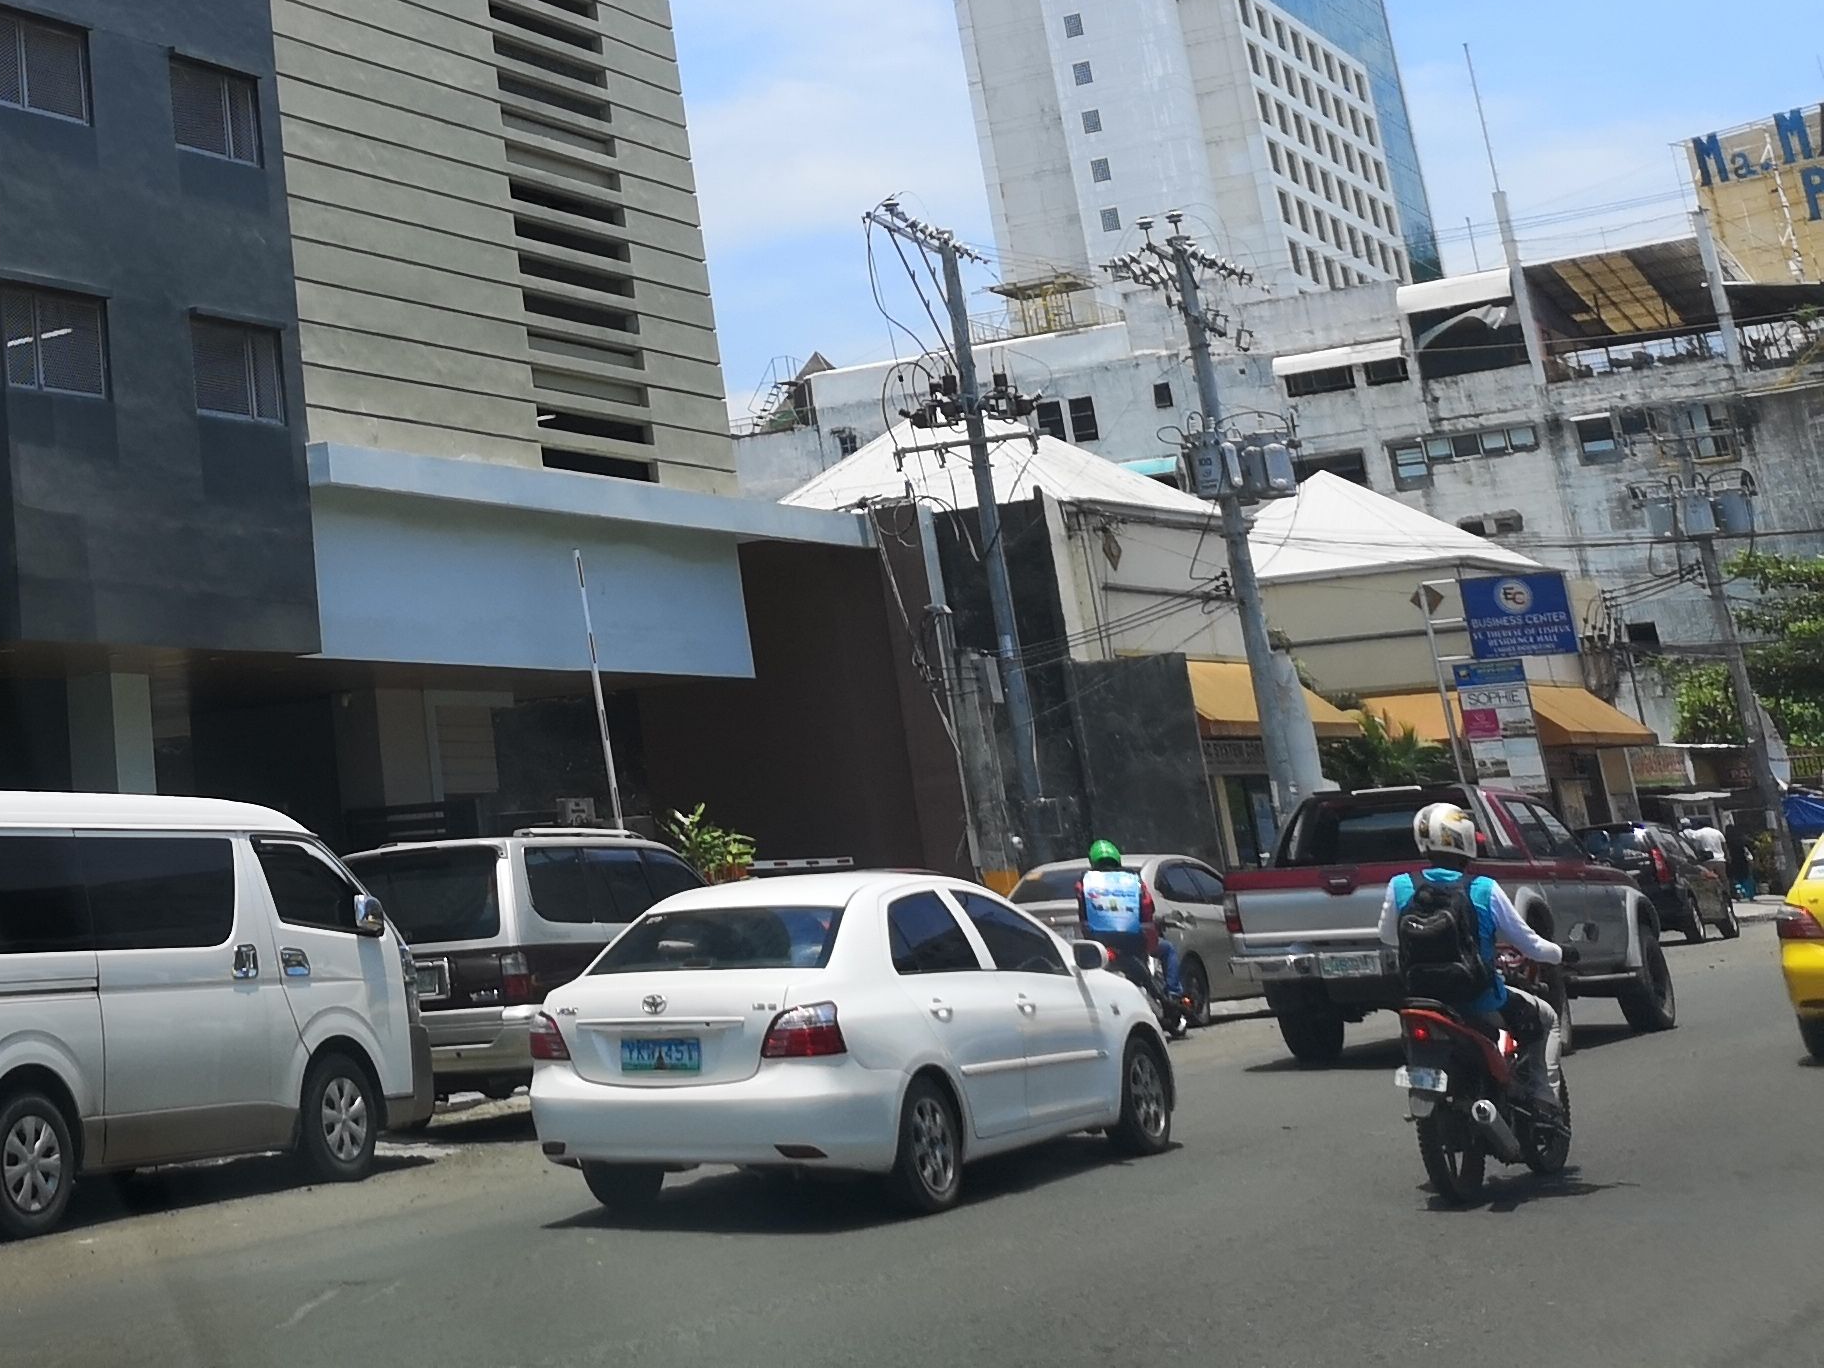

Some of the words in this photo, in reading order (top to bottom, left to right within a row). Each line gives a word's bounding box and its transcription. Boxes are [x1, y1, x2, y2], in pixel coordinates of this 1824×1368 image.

[1471, 615, 1522, 629] BUSINESS
[1525, 611, 1567, 624] CENTER
[1467, 689, 1522, 706] SOPHIE
